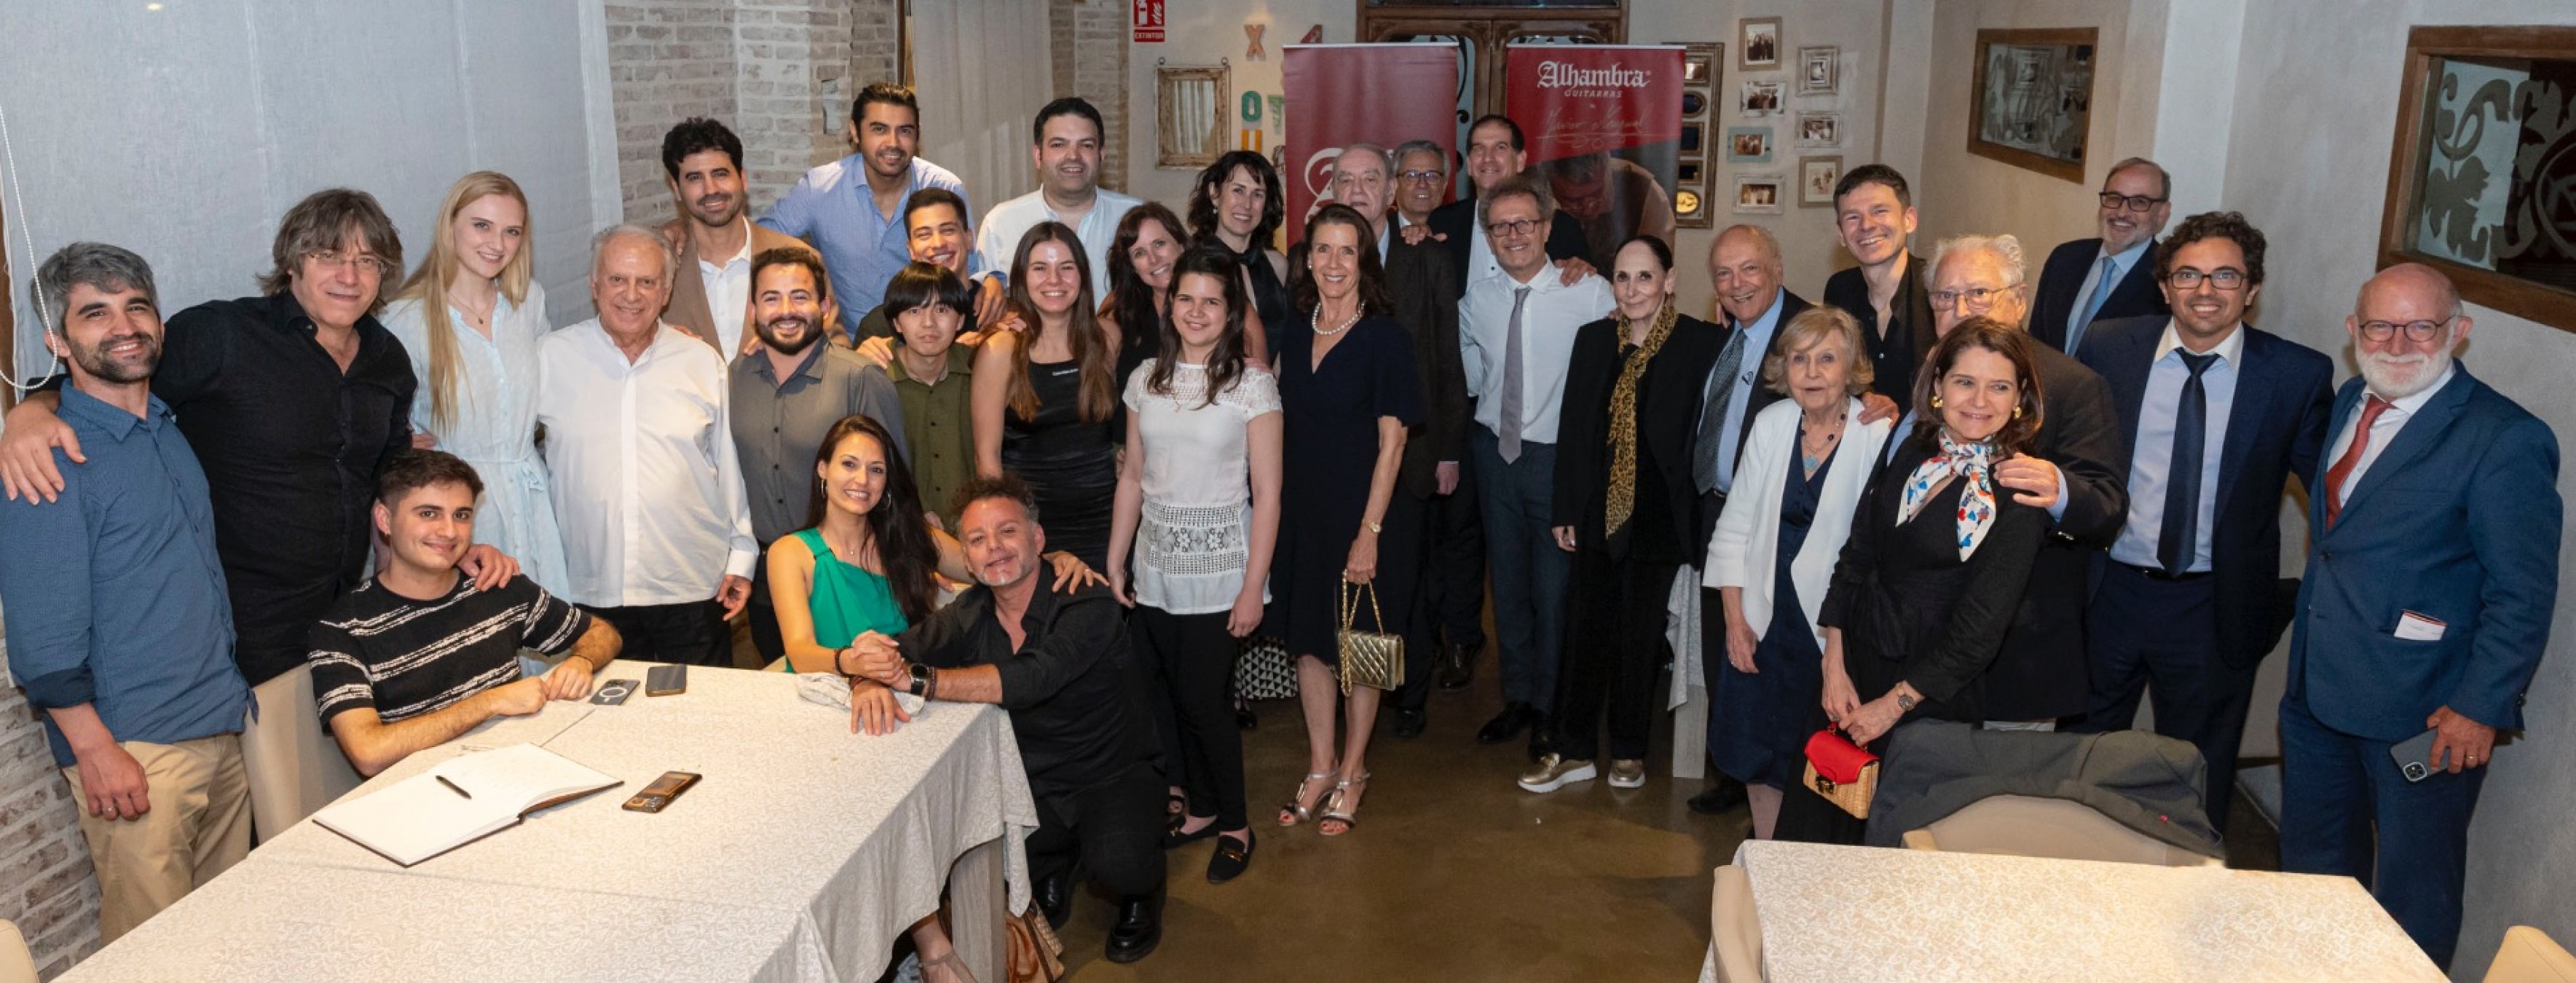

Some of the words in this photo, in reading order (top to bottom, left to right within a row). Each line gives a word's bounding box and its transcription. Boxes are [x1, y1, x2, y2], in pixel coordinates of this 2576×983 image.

[1244, 24, 1266, 58] X
[1537, 60, 1651, 90] Alhambra
[1564, 90, 1623, 98] GUITARRAS
